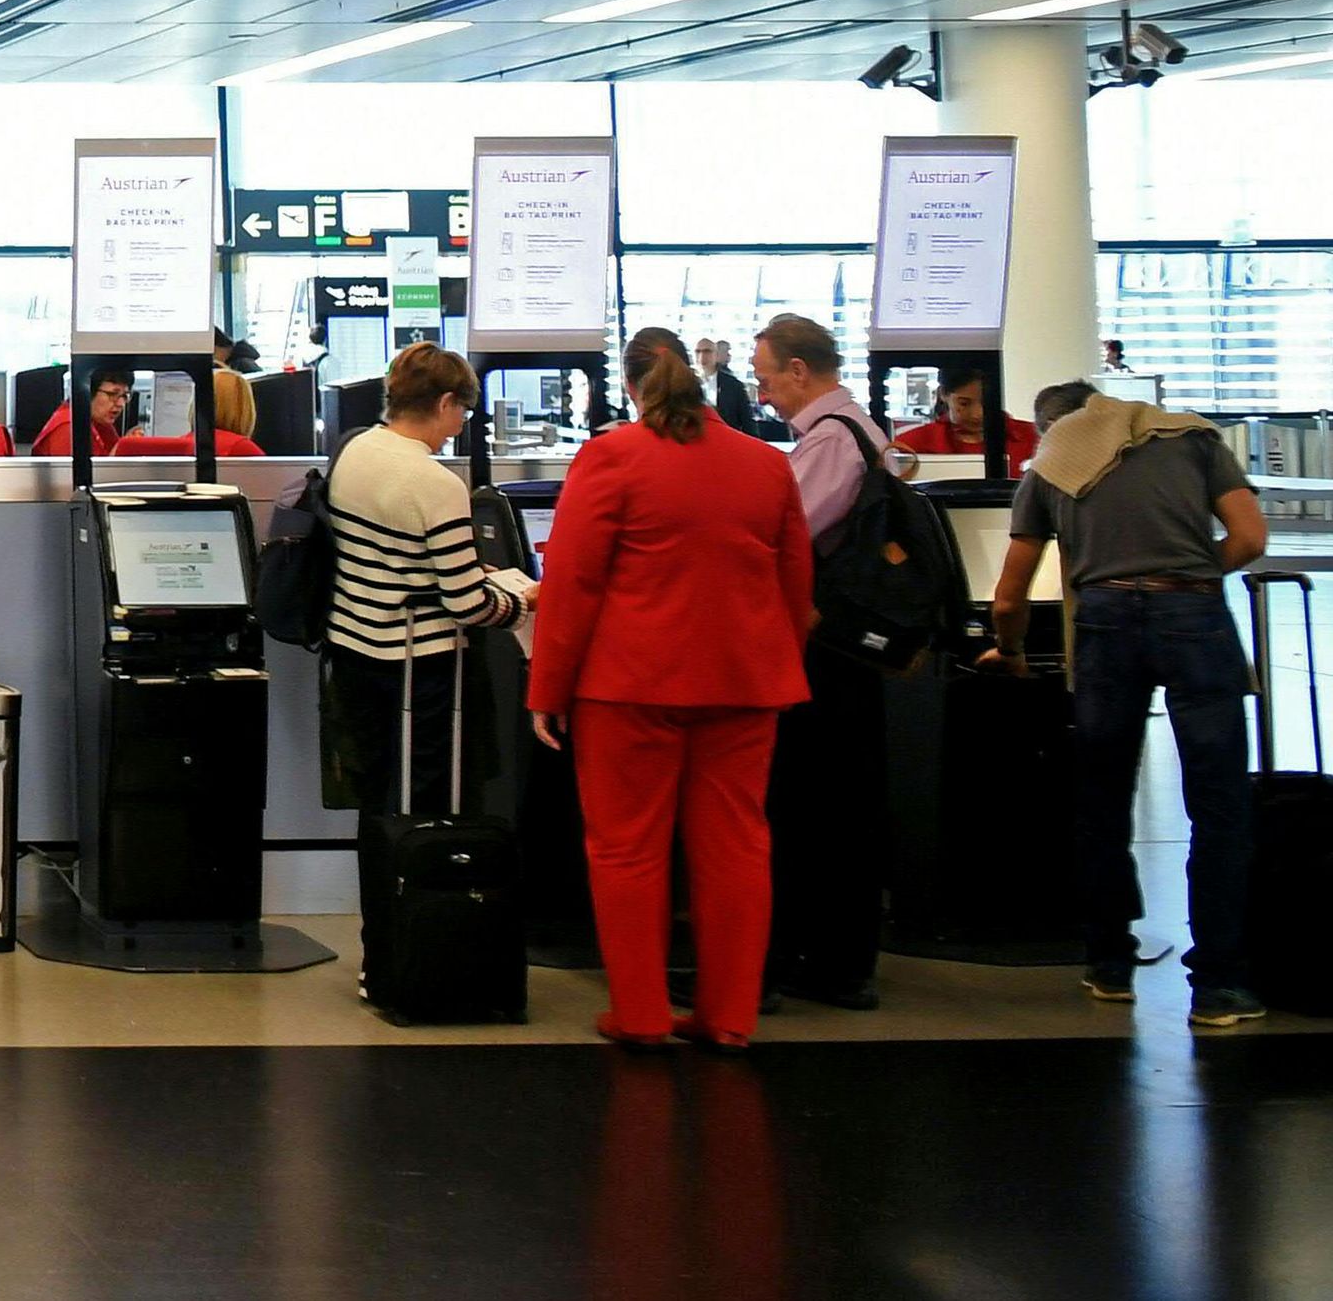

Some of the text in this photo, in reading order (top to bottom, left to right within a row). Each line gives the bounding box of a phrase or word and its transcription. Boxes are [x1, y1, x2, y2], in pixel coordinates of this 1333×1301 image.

[101, 176, 168, 190] Austrian
[501, 170, 566, 183] Austrian
[908, 171, 970, 184] Austrian
[315, 205, 472, 236] F B
